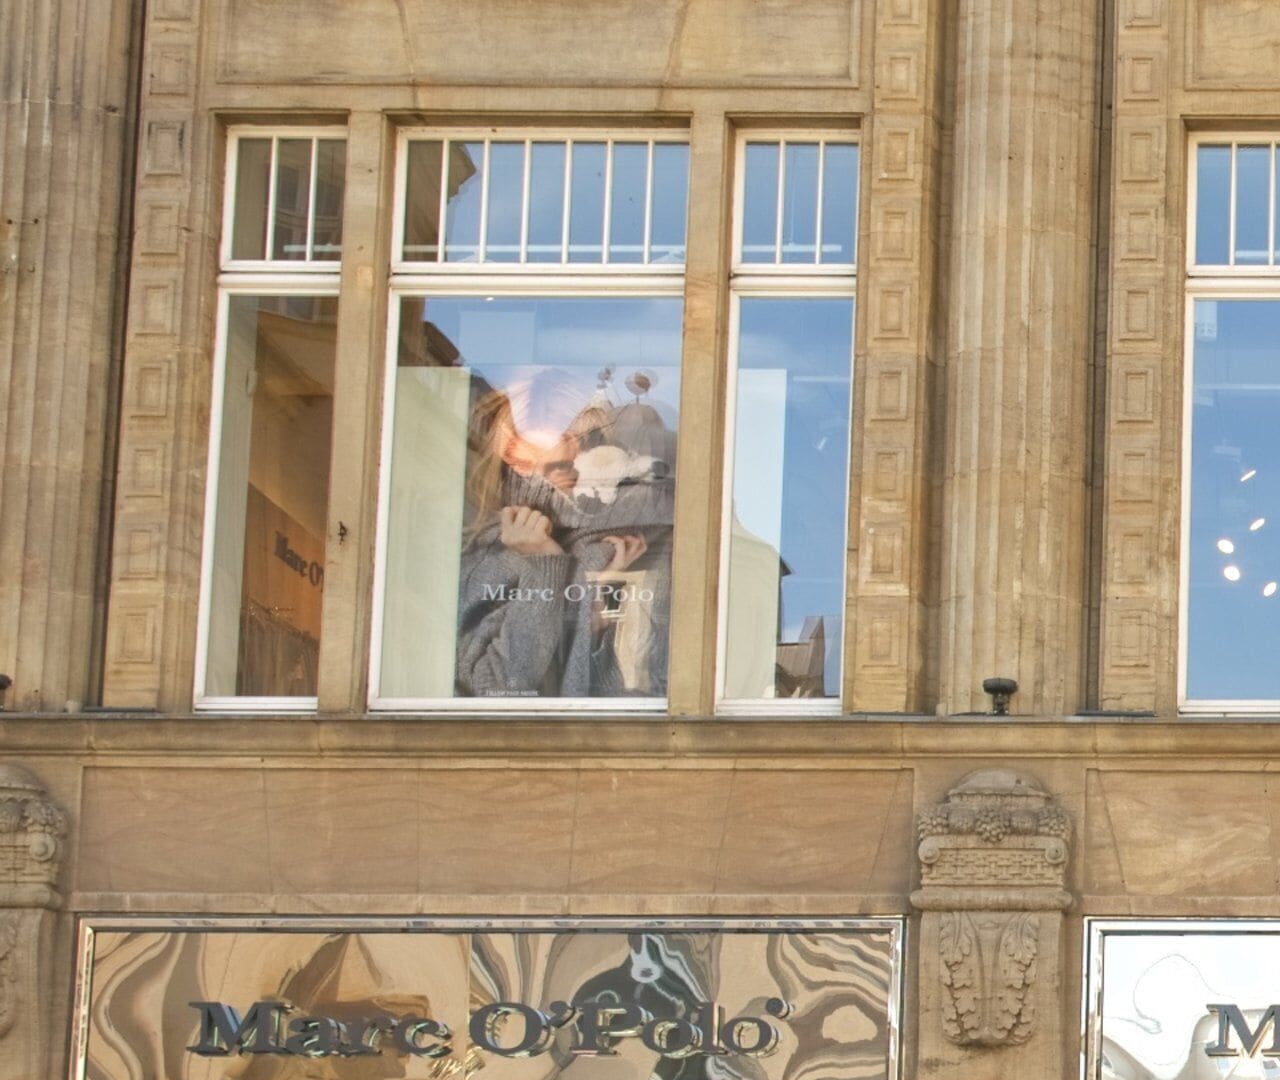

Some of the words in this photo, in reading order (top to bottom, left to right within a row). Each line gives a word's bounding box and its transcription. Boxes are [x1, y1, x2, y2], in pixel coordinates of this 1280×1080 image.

[481, 583, 554, 602] Marc
[563, 583, 654, 602] O'Polo
[186, 1001, 453, 1058] Marc
[468, 997, 780, 1058] O'Polo
